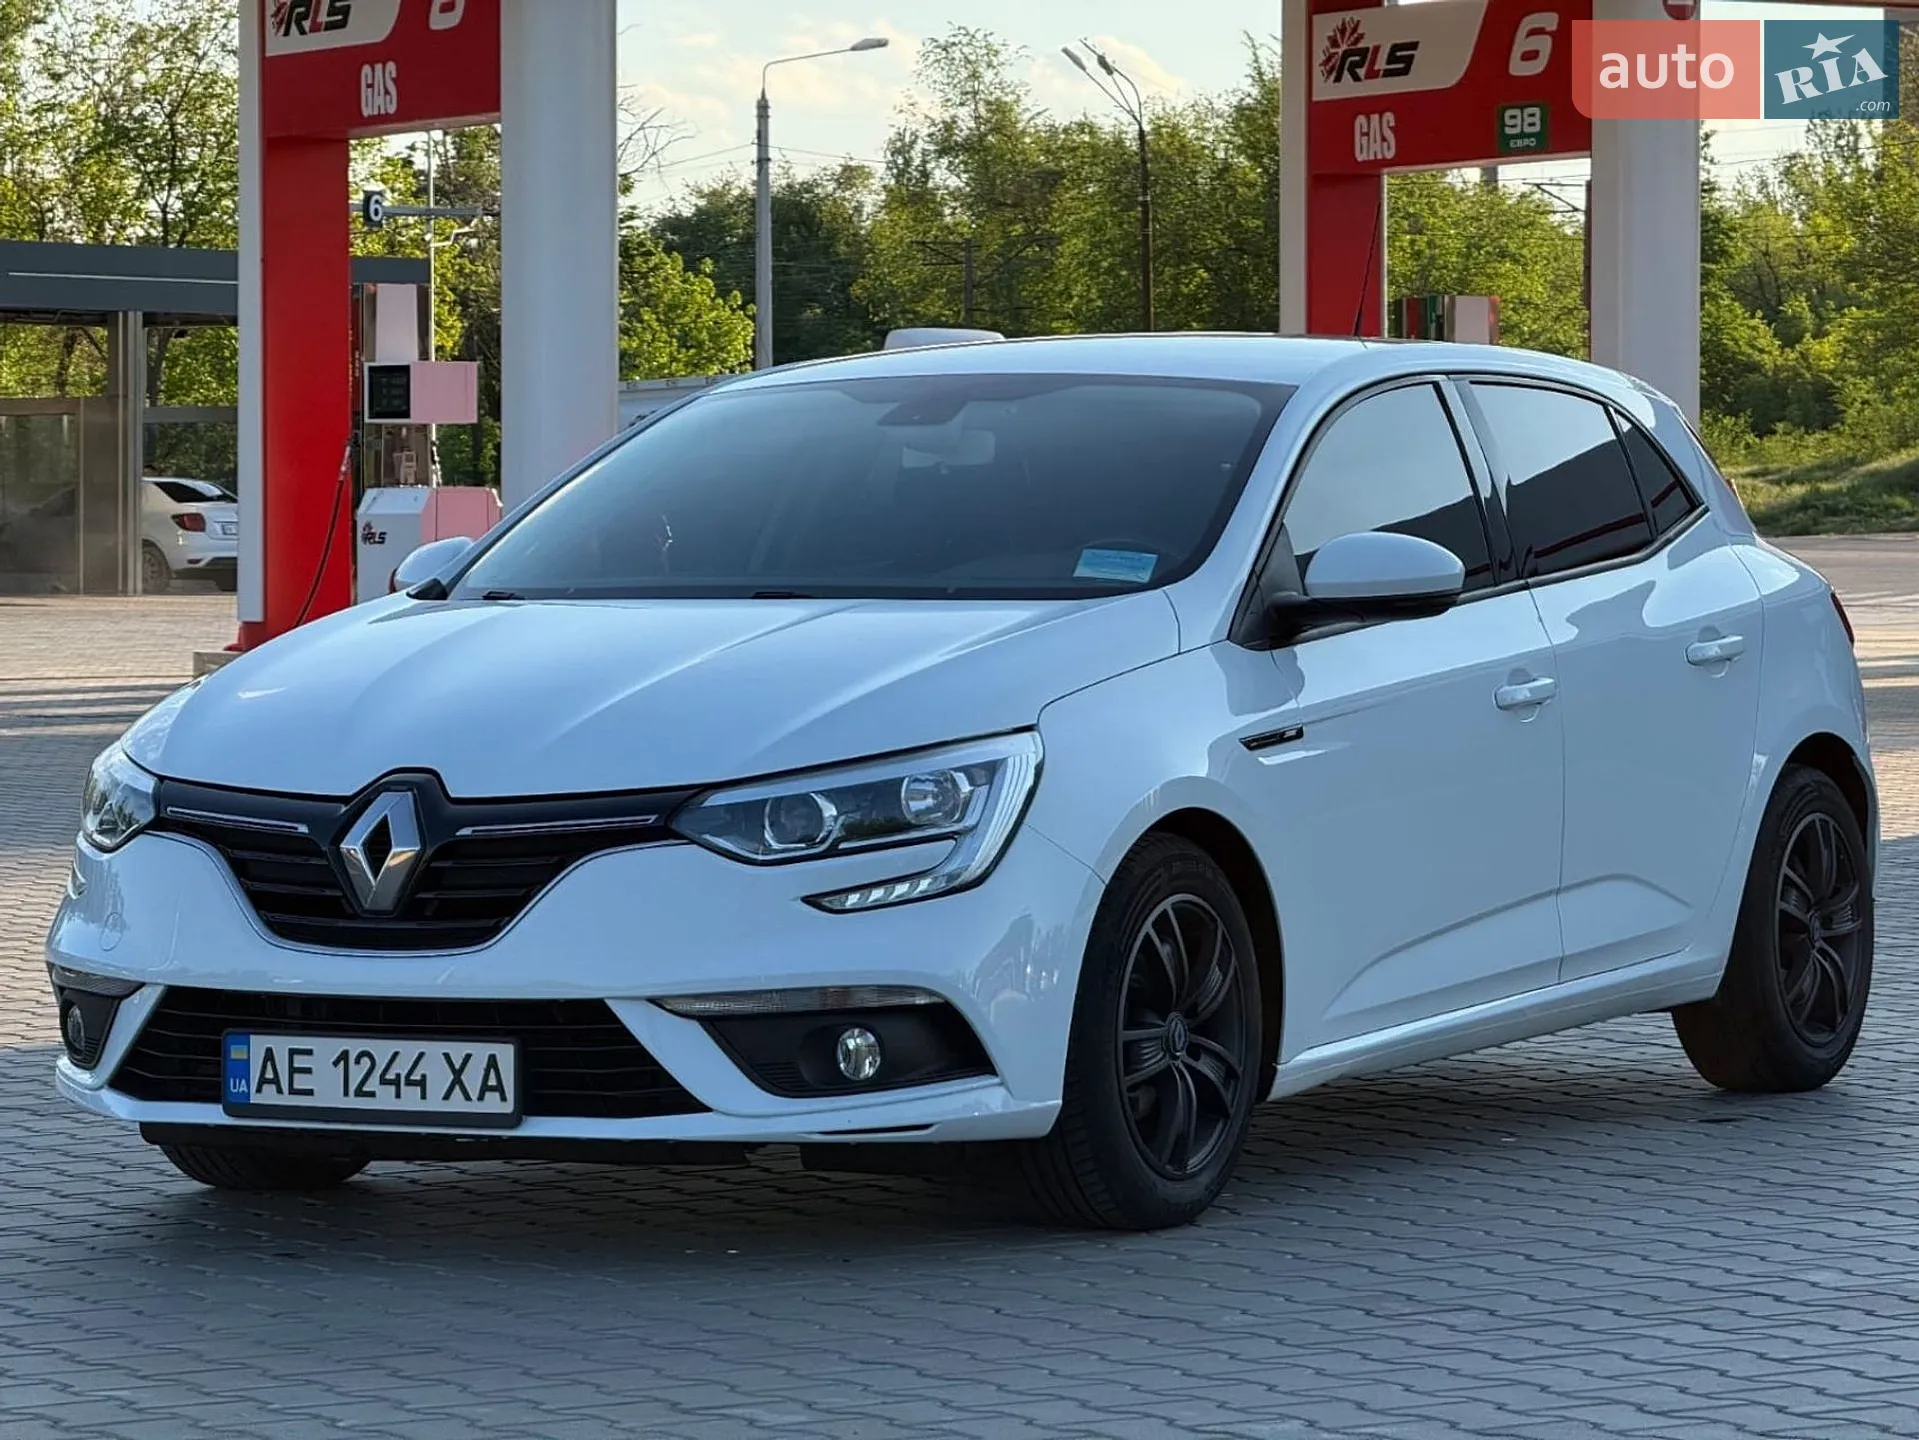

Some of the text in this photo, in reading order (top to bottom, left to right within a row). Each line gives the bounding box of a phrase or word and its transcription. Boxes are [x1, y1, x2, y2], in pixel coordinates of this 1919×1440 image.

[282, 0, 351, 37] RLS
[1333, 40, 1420, 84] RLS
[1508, 11, 1560, 77] 6
[360, 60, 398, 118] GAS
[1354, 110, 1396, 163] GAS
[1503, 106, 1542, 135] 98
[369, 194, 383, 222] 6
[230, 1077, 249, 1093] UA
[255, 1046, 508, 1103] AE 1244 XA
